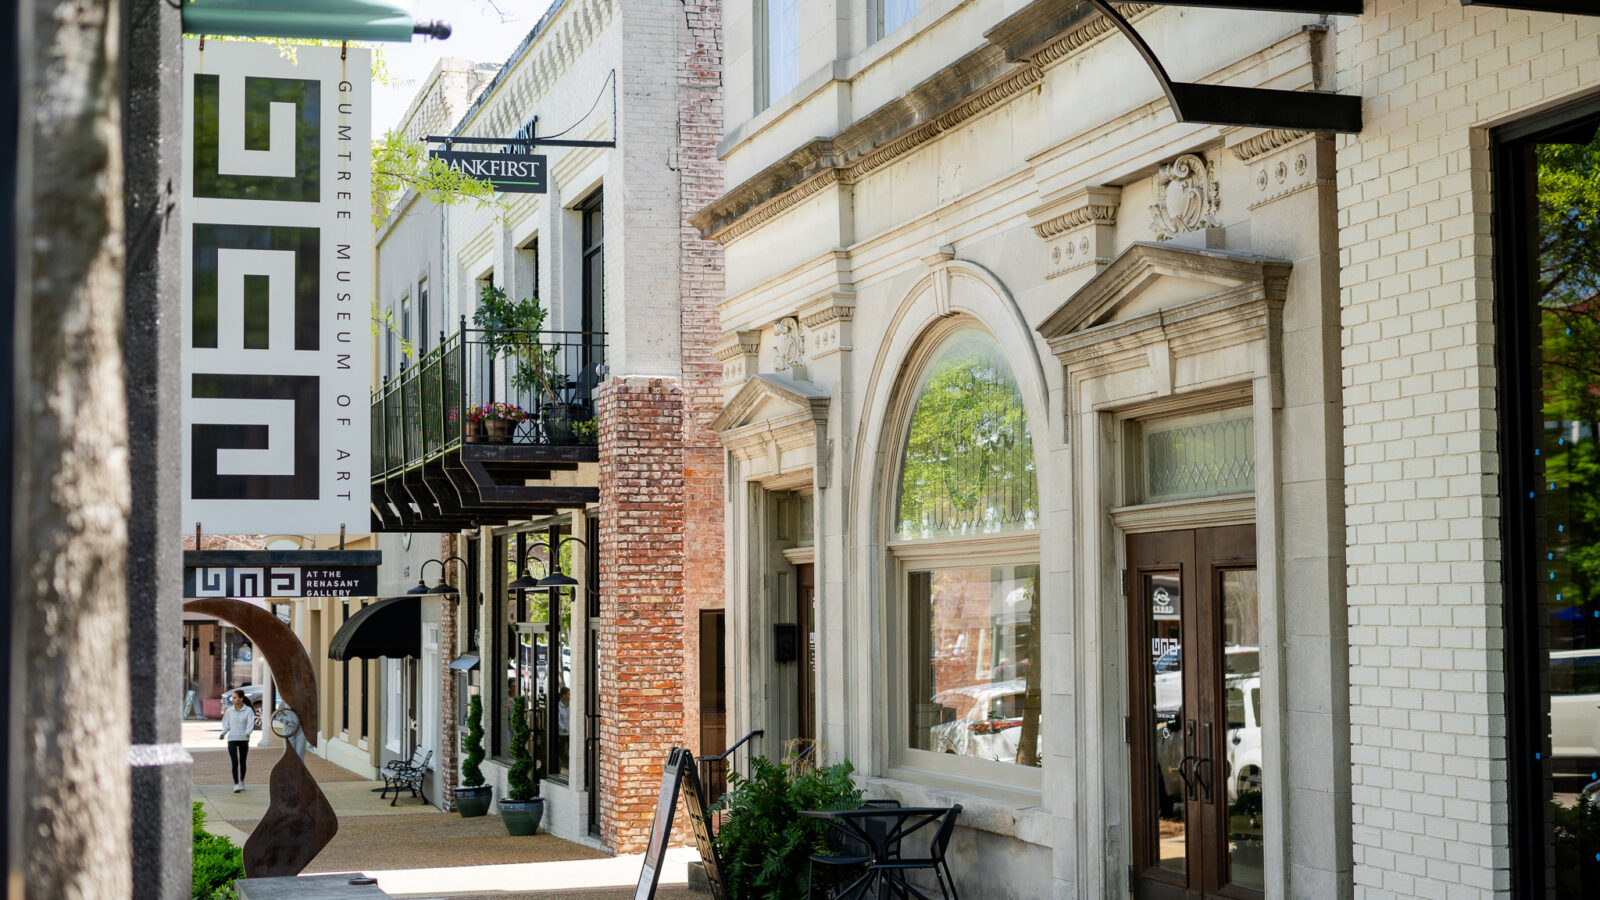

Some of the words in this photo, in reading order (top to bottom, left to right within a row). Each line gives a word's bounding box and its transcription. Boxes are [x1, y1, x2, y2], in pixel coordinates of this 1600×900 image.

[337, 80, 353, 220] GUMTREE
[336, 244, 352, 370] MUSEUM
[336, 394, 351, 426] OF
[336, 449, 351, 502] ART
[306, 570, 319, 578] AT
[322, 570, 342, 578] THE
[306, 580, 360, 588] RENASANT
[306, 589, 351, 597] GALLERY
